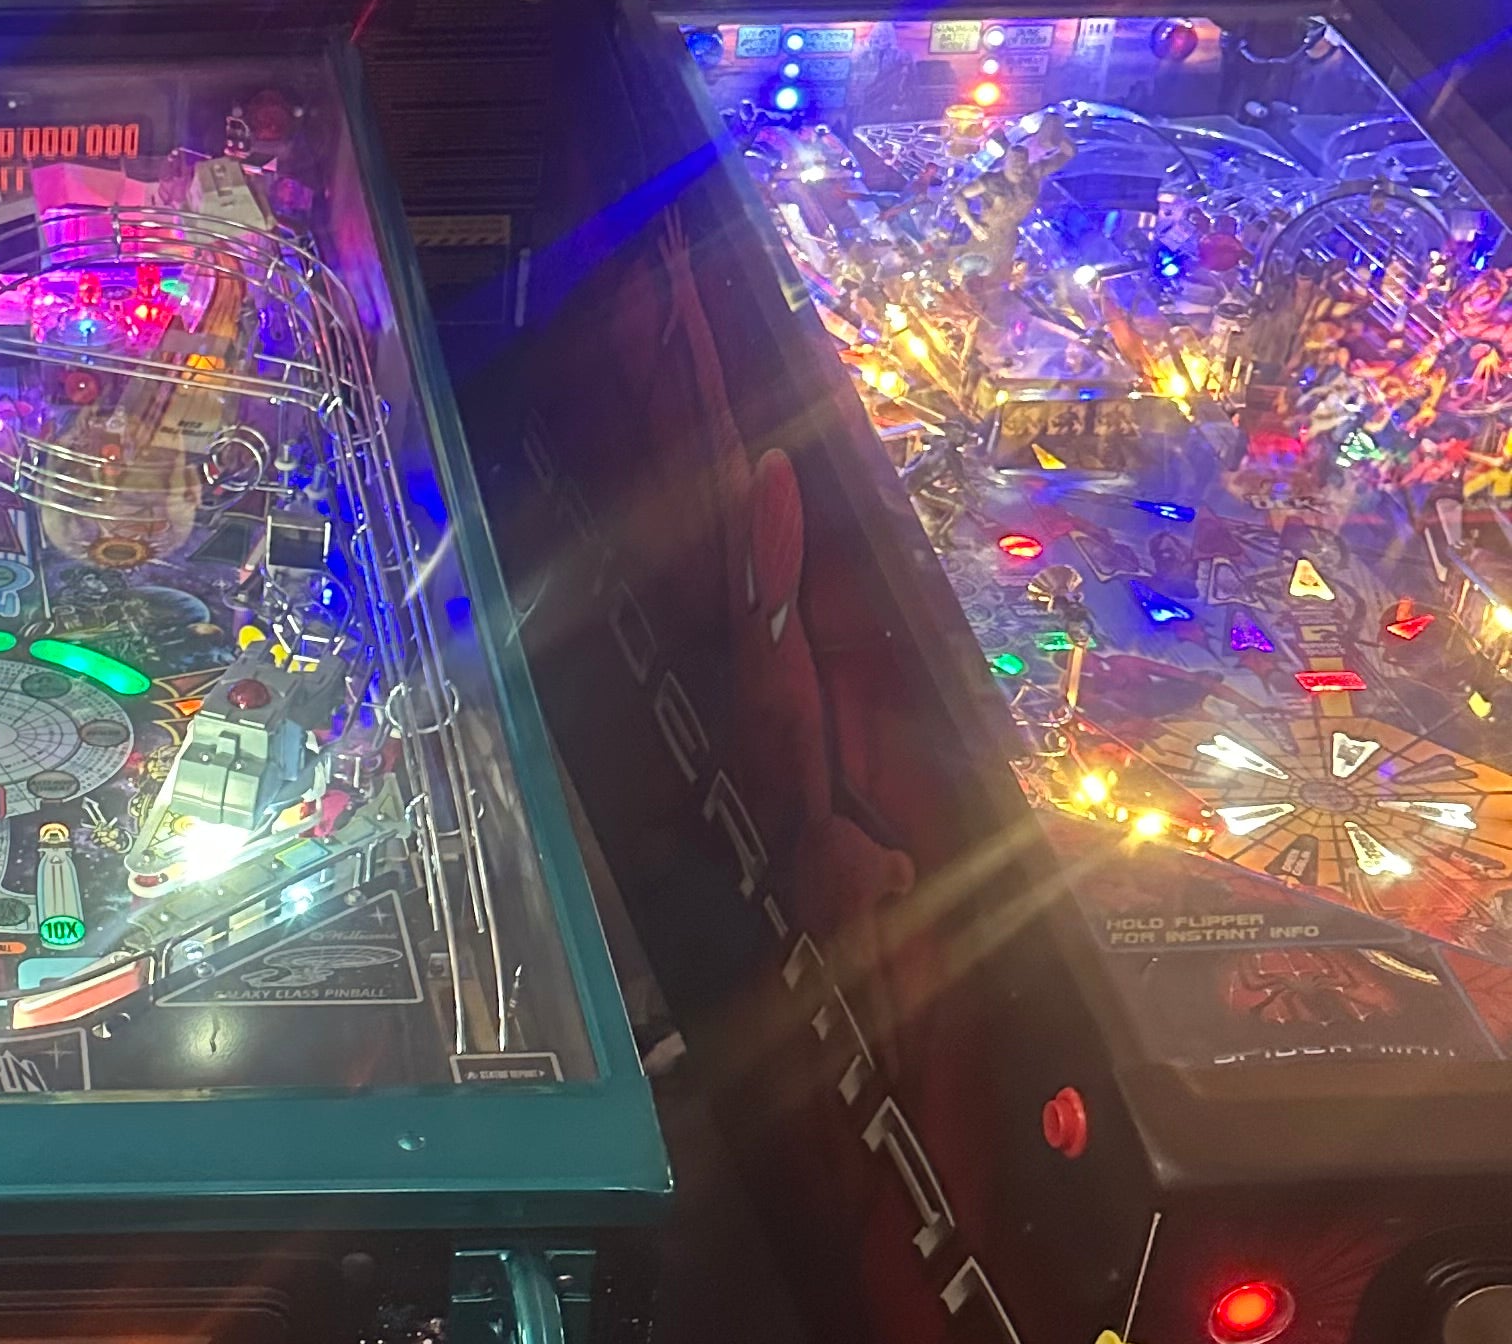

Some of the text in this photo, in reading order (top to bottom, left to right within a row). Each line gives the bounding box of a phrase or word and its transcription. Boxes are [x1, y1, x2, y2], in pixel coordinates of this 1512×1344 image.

[45, 921, 79, 940] 10X
[1106, 913, 1265, 931] HOLD FLIPPER
[1110, 925, 1321, 945] FOR INSTANT INFO
[275, 989, 319, 999] CLASS
[324, 988, 387, 999] PINBALL
